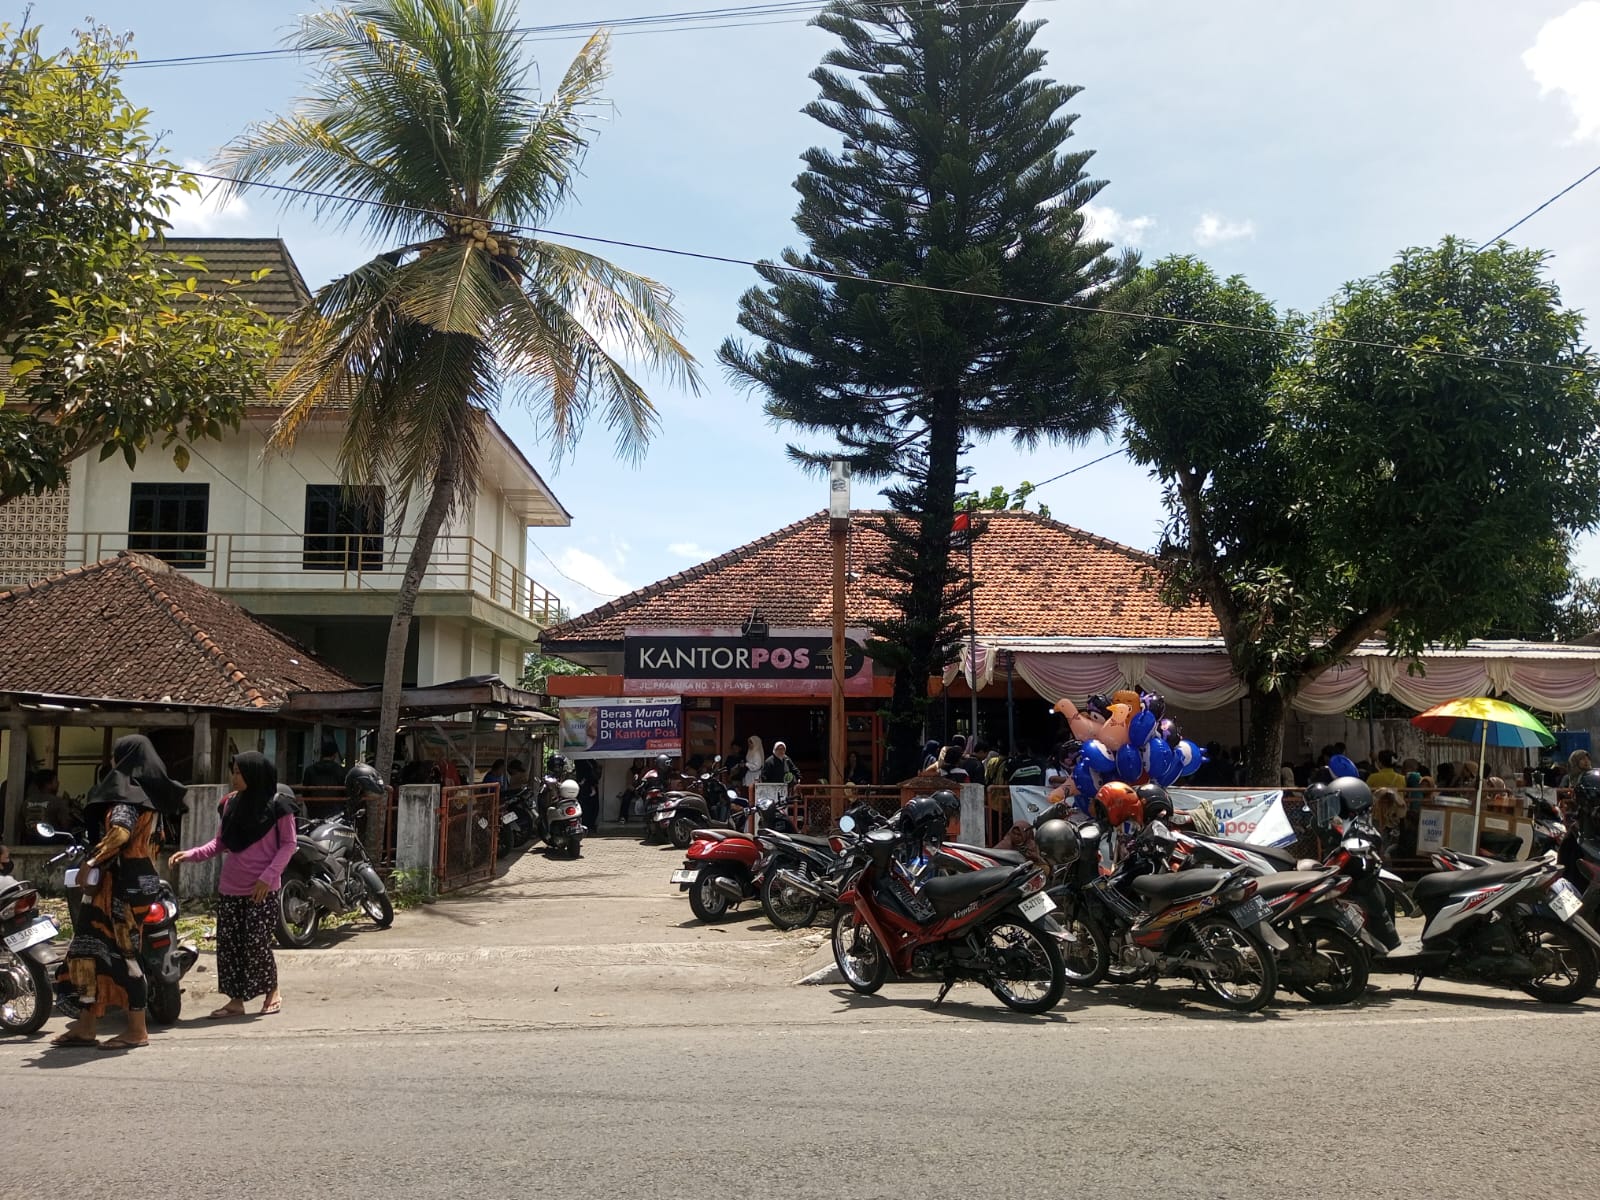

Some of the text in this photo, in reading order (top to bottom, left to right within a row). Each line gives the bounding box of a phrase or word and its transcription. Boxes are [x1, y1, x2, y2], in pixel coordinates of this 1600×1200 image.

[653, 681, 694, 690] PRAMUKA
[724, 681, 755, 690] PLAYEN
[600, 708, 670, 719] Beras Murah
[600, 718, 677, 729] Dekat Rumah,
[600, 730, 612, 740] Di
[615, 730, 652, 739] Kantor
